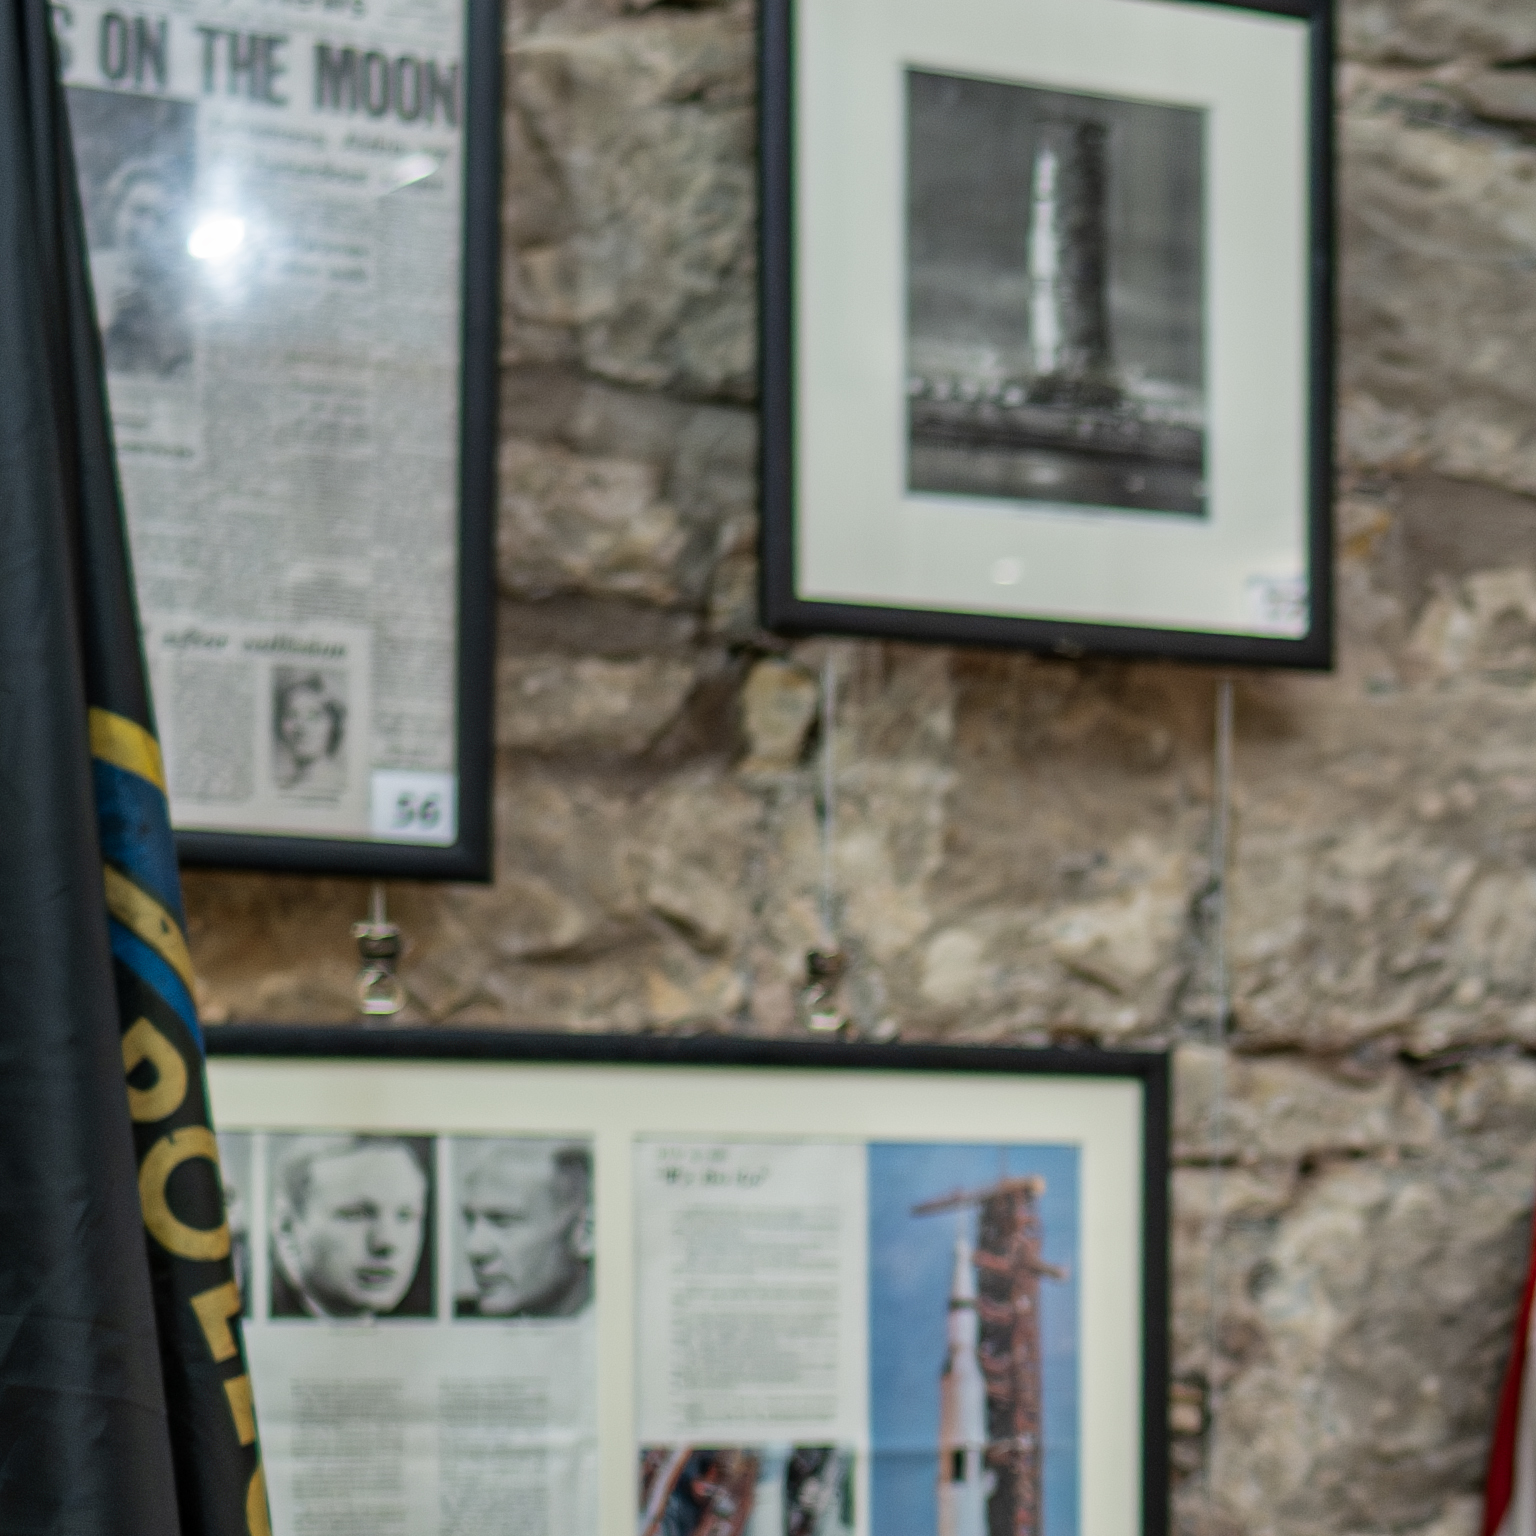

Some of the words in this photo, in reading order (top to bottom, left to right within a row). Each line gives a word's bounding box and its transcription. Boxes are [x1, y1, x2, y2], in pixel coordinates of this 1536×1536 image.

[100, 12, 168, 87] ON
[196, 24, 288, 106] THE
[315, 41, 461, 128] MOON
